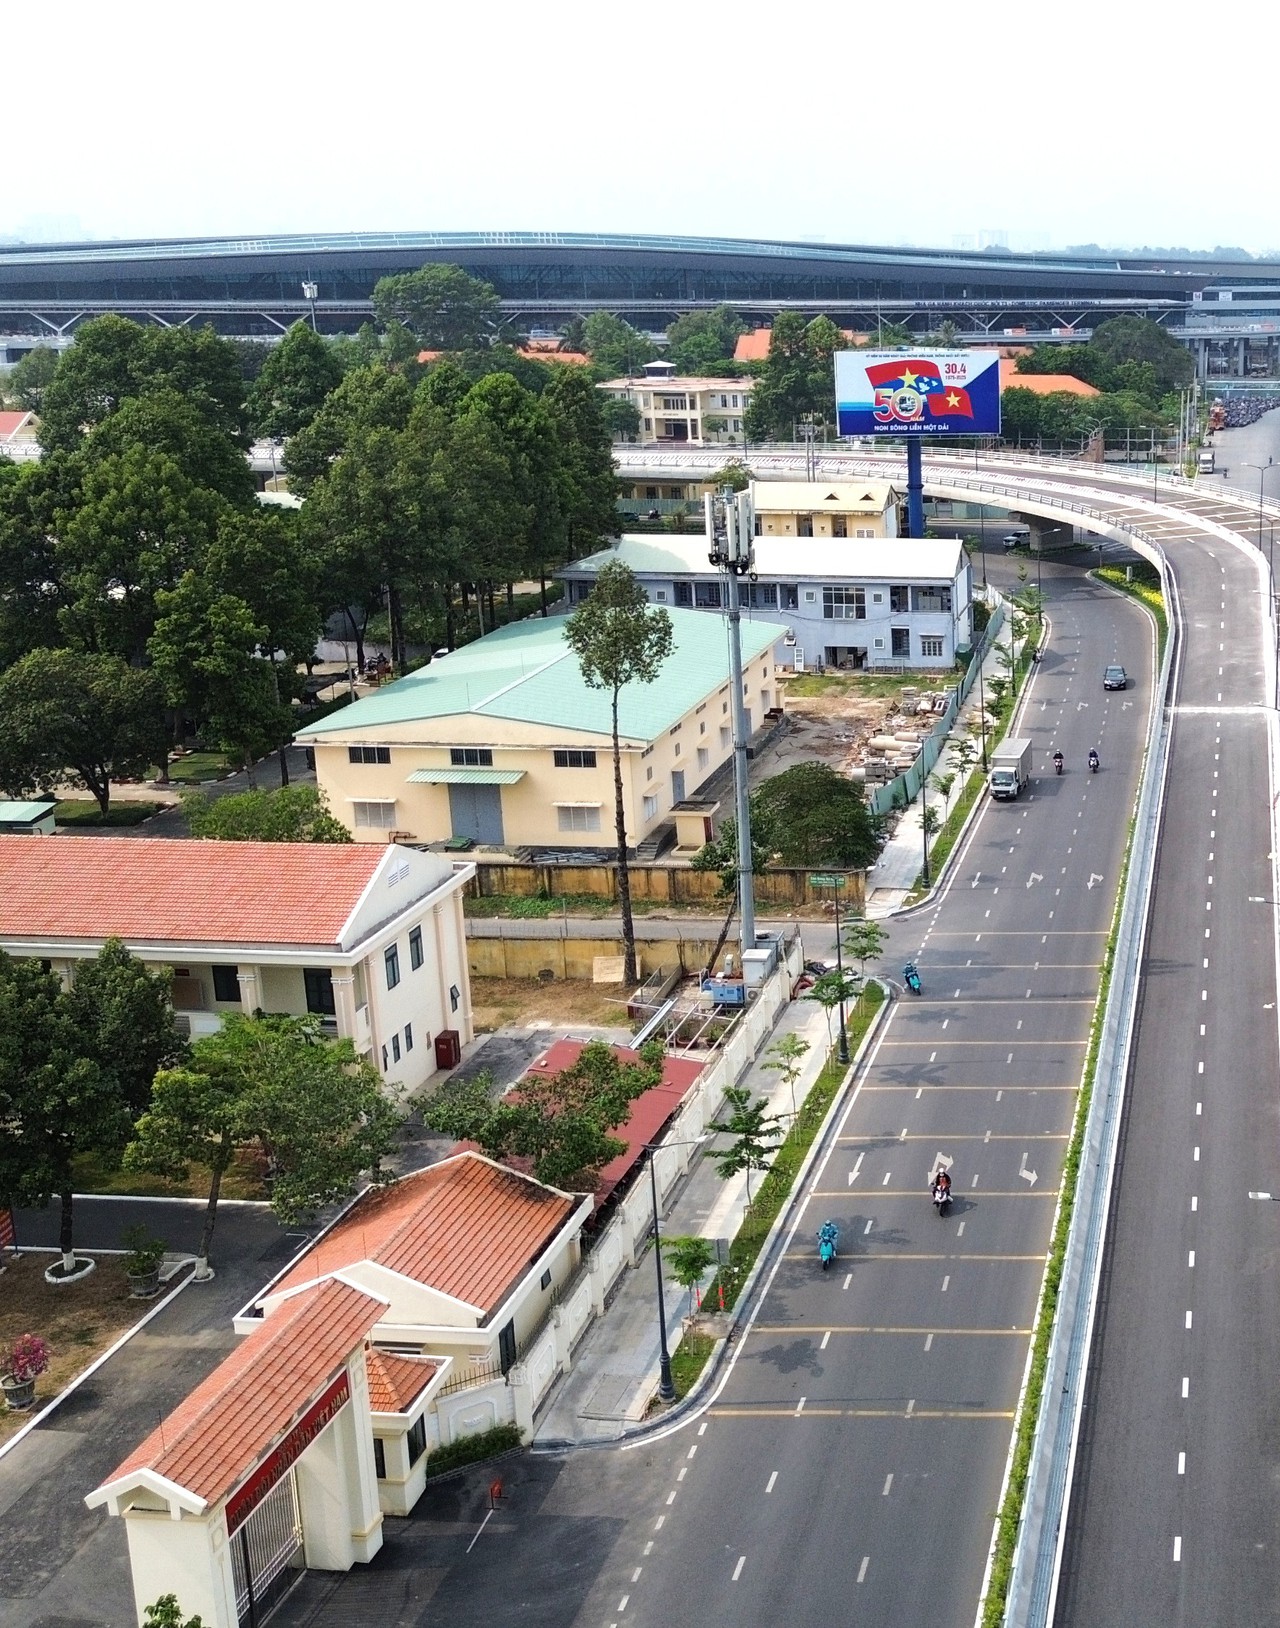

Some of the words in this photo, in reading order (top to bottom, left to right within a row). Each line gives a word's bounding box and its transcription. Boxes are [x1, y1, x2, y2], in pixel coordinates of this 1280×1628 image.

[945, 363, 966, 374] 30.4
[873, 387, 923, 422] 50
[923, 424, 937, 432] MỘT
[331, 1387, 349, 1415] NAM
